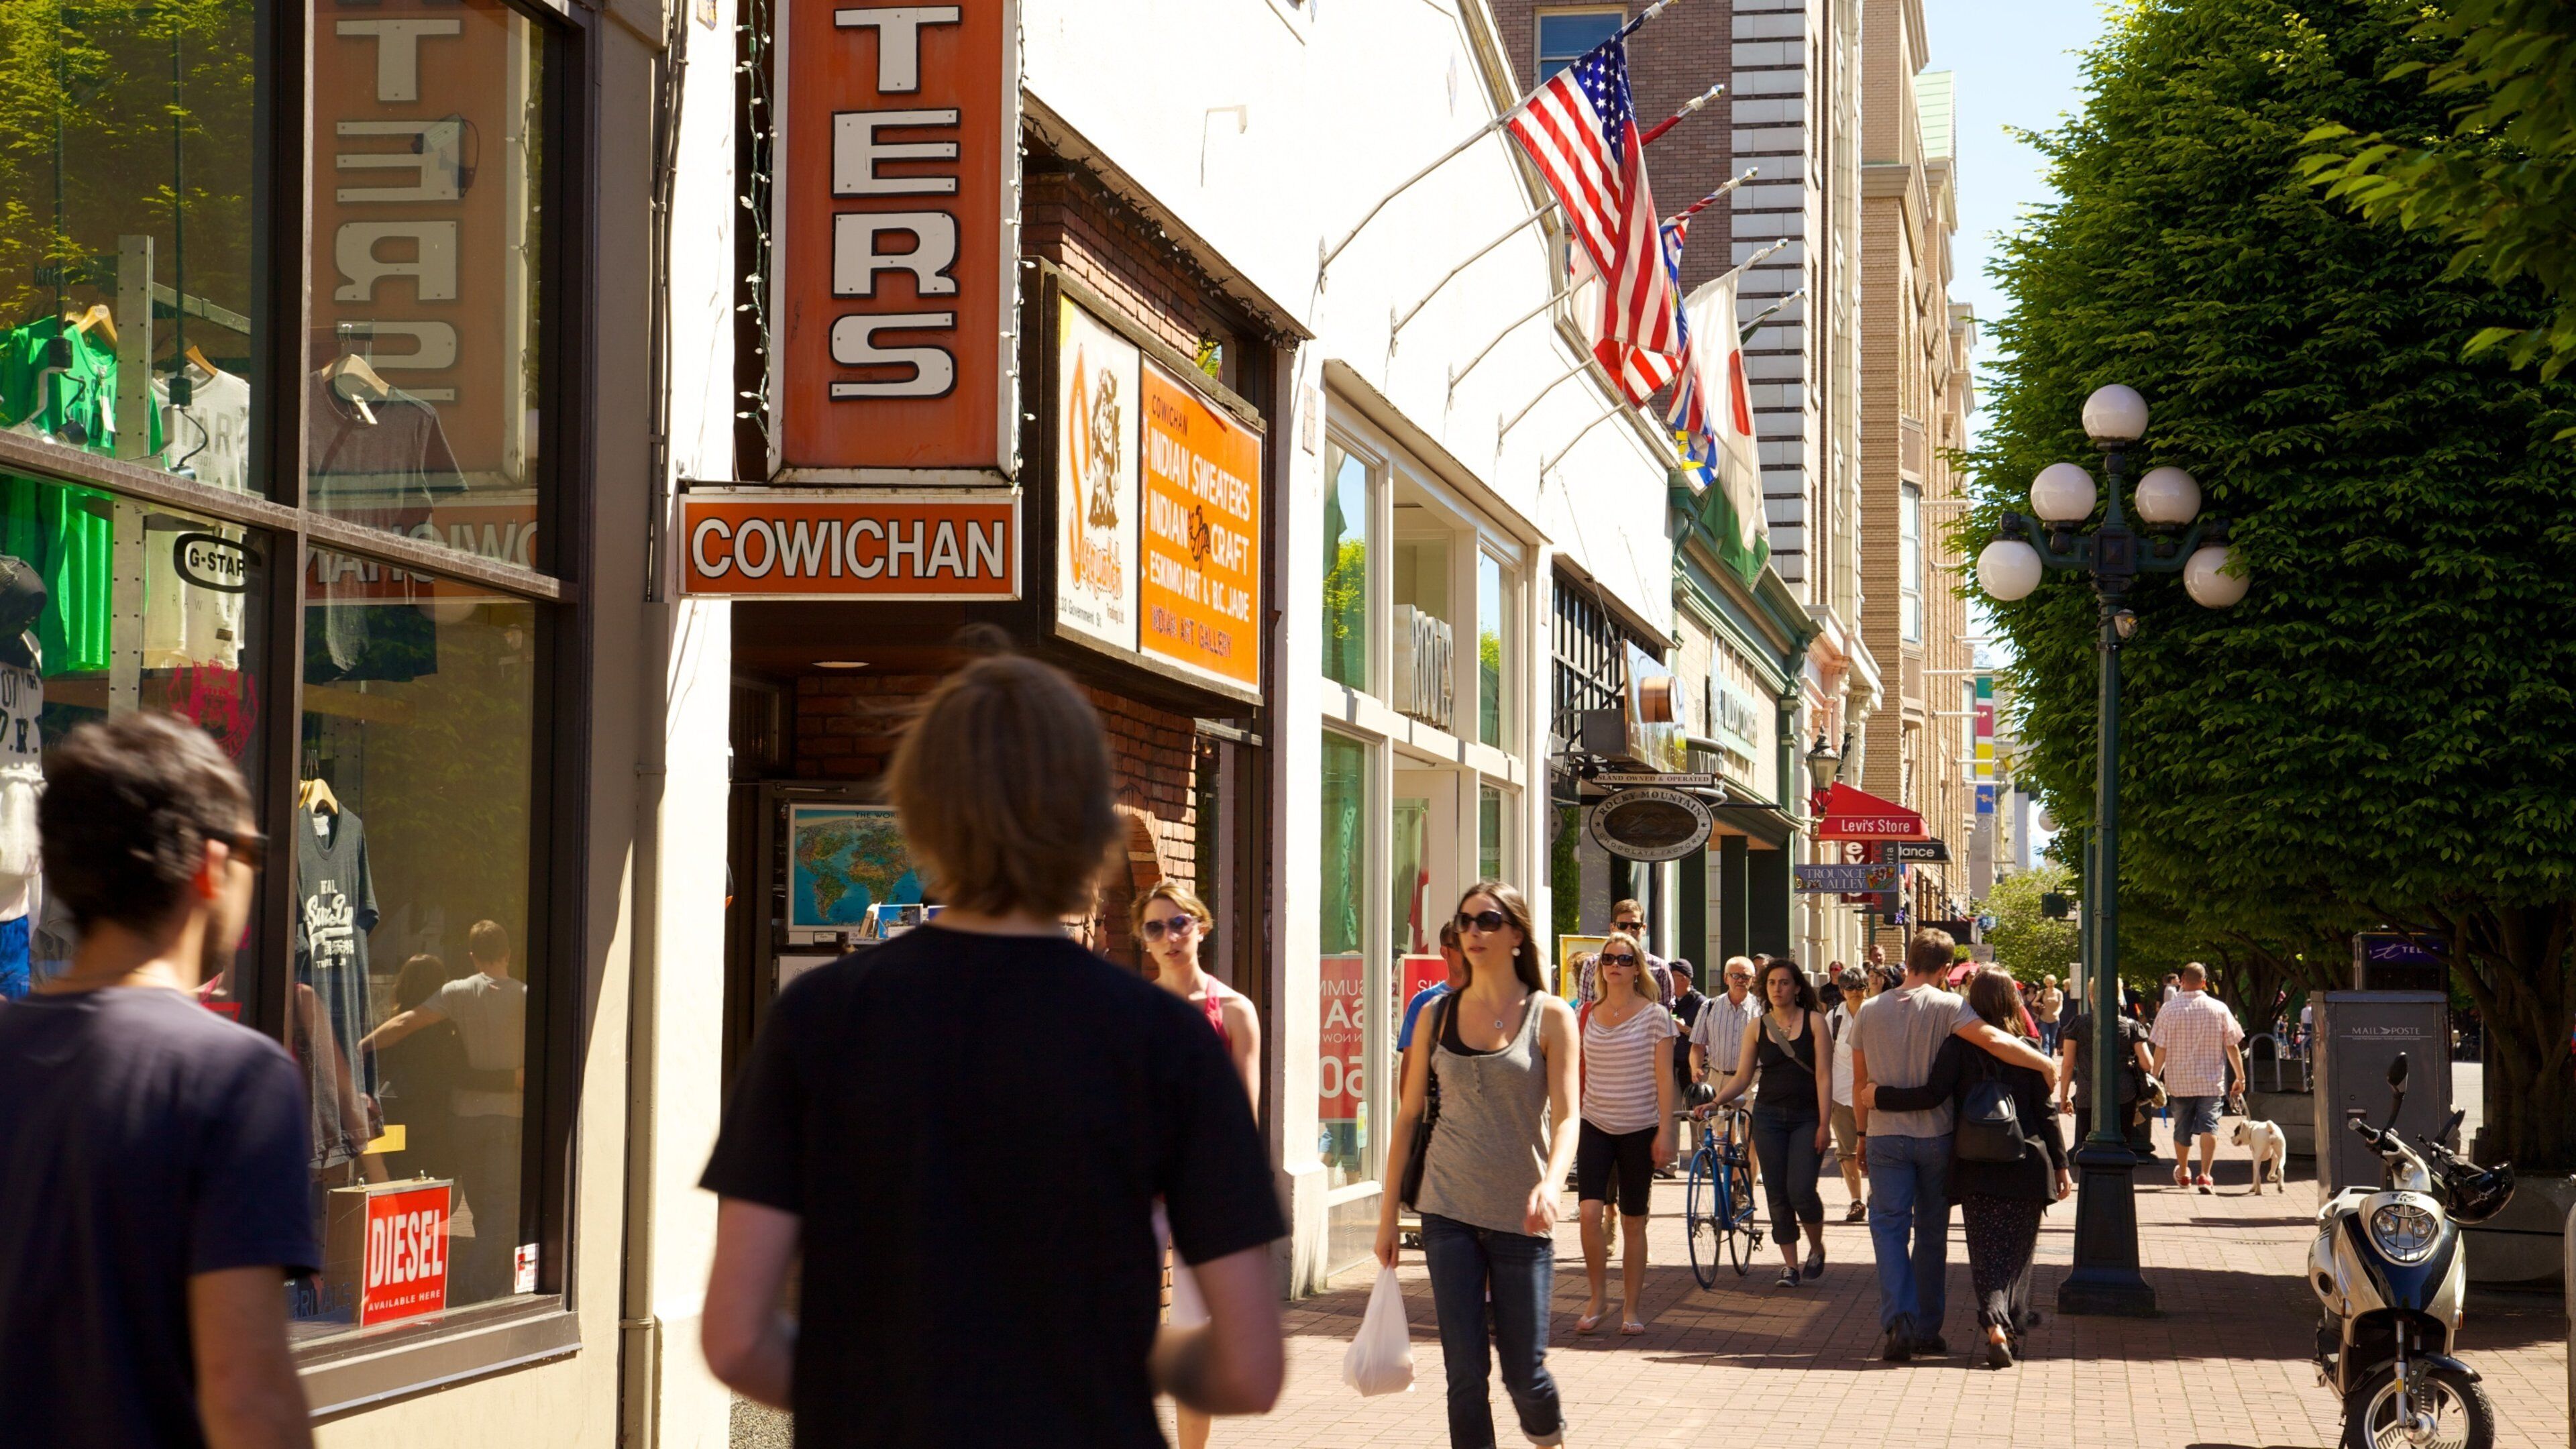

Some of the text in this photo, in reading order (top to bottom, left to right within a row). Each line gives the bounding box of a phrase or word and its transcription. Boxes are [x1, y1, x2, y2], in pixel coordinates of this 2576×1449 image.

[1152, 394, 1188, 436] COWICHAN
[1150, 427, 1250, 522] INDIAN SWEATERS
[1150, 489, 1250, 576] INDIAN CRAFT
[189, 547, 246, 578] G-STAR
[692, 517, 1005, 580] COWICHAN
[1150, 549, 1183, 596] ESKIMO
[1184, 567, 1201, 603] ART
[1203, 576, 1209, 605] &
[1227, 587, 1250, 623] JADE
[1069, 599, 1095, 625] Government
[1152, 604, 1232, 658] INDIAN ART GALLERY
[1599, 791, 1704, 816] ROCKY MOUNTAIN
[1841, 818, 1911, 833] Levi's Store
[1599, 833, 1703, 857] CHOCOLATE FACTORY
[1805, 868, 1866, 879] TROUNCE
[1826, 878, 1865, 889] ALLEY
[370, 1209, 443, 1289] DIESEL
[368, 1289, 441, 1312] AVAILABLE HERE
